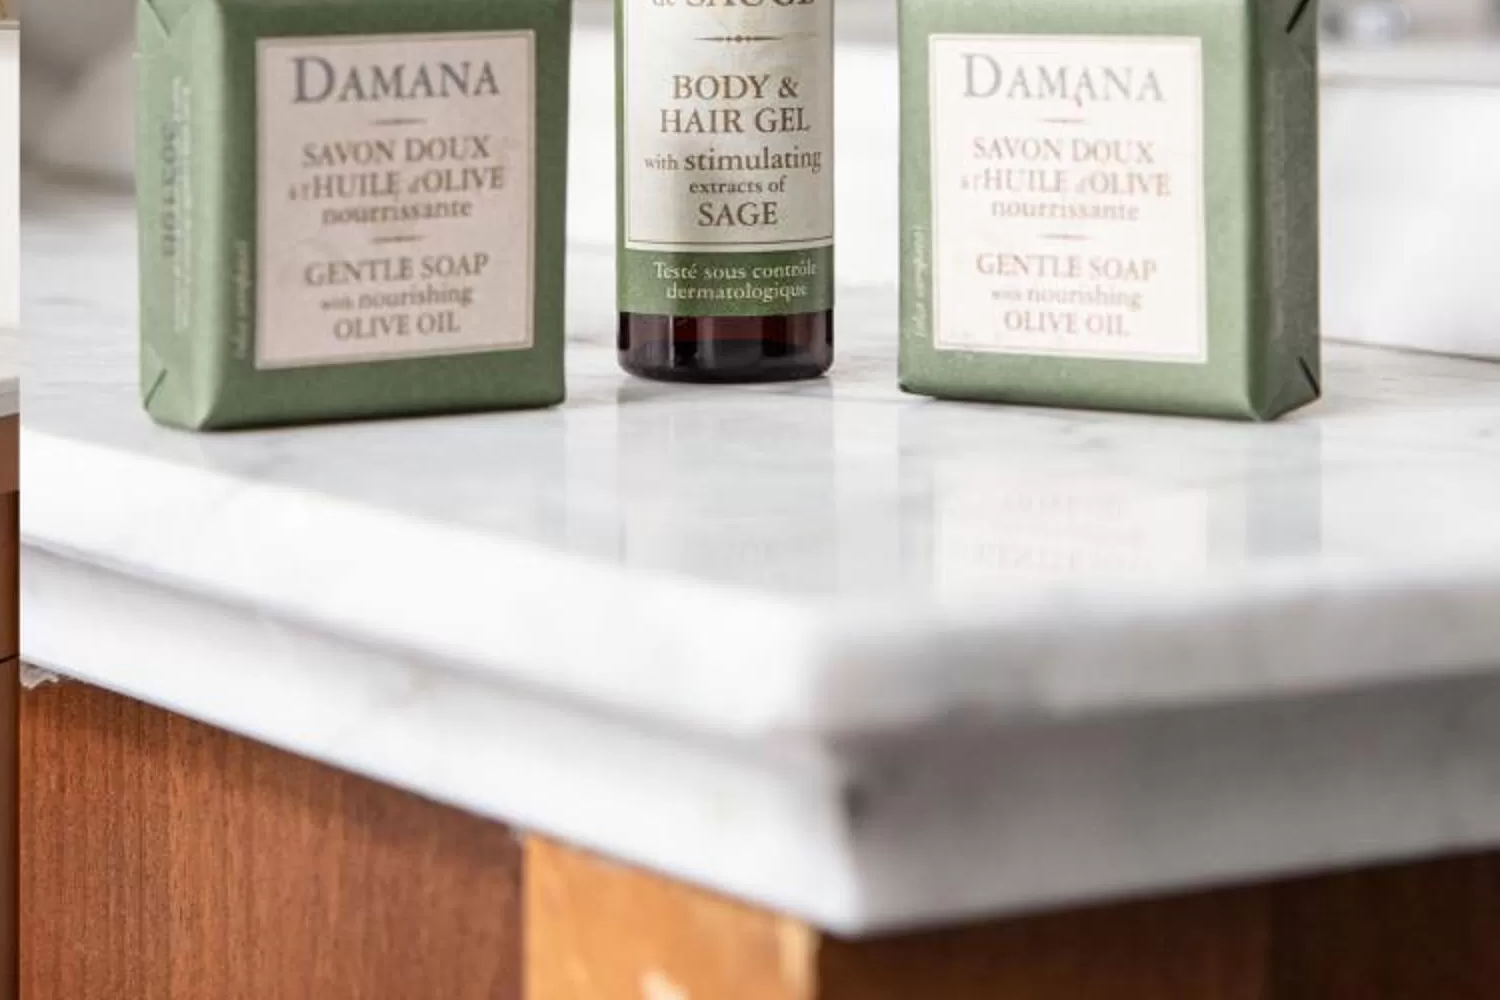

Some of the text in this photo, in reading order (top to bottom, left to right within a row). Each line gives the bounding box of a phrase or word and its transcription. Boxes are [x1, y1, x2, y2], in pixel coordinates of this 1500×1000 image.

[289, 55, 500, 104] DAMANA
[672, 74, 799, 100] BODY &
[960, 52, 1166, 102] DAMANA
[660, 107, 811, 133] HAIR GEL
[301, 134, 491, 167] SAVON DOUX
[644, 146, 822, 173] with stimulating
[972, 136, 1155, 164] SAVON DOUX
[688, 176, 785, 194] extracts of
[697, 201, 779, 226] SAGE
[304, 252, 490, 286] GENTLE SOAP
[653, 261, 697, 281] Testé
[703, 266, 746, 281] sous
[976, 252, 1157, 281] GENTLE SOAP
[666, 281, 808, 303] dermatologique
[332, 311, 461, 341] OLIVE OIL
[1003, 309, 1130, 337] OLIVE OIL
